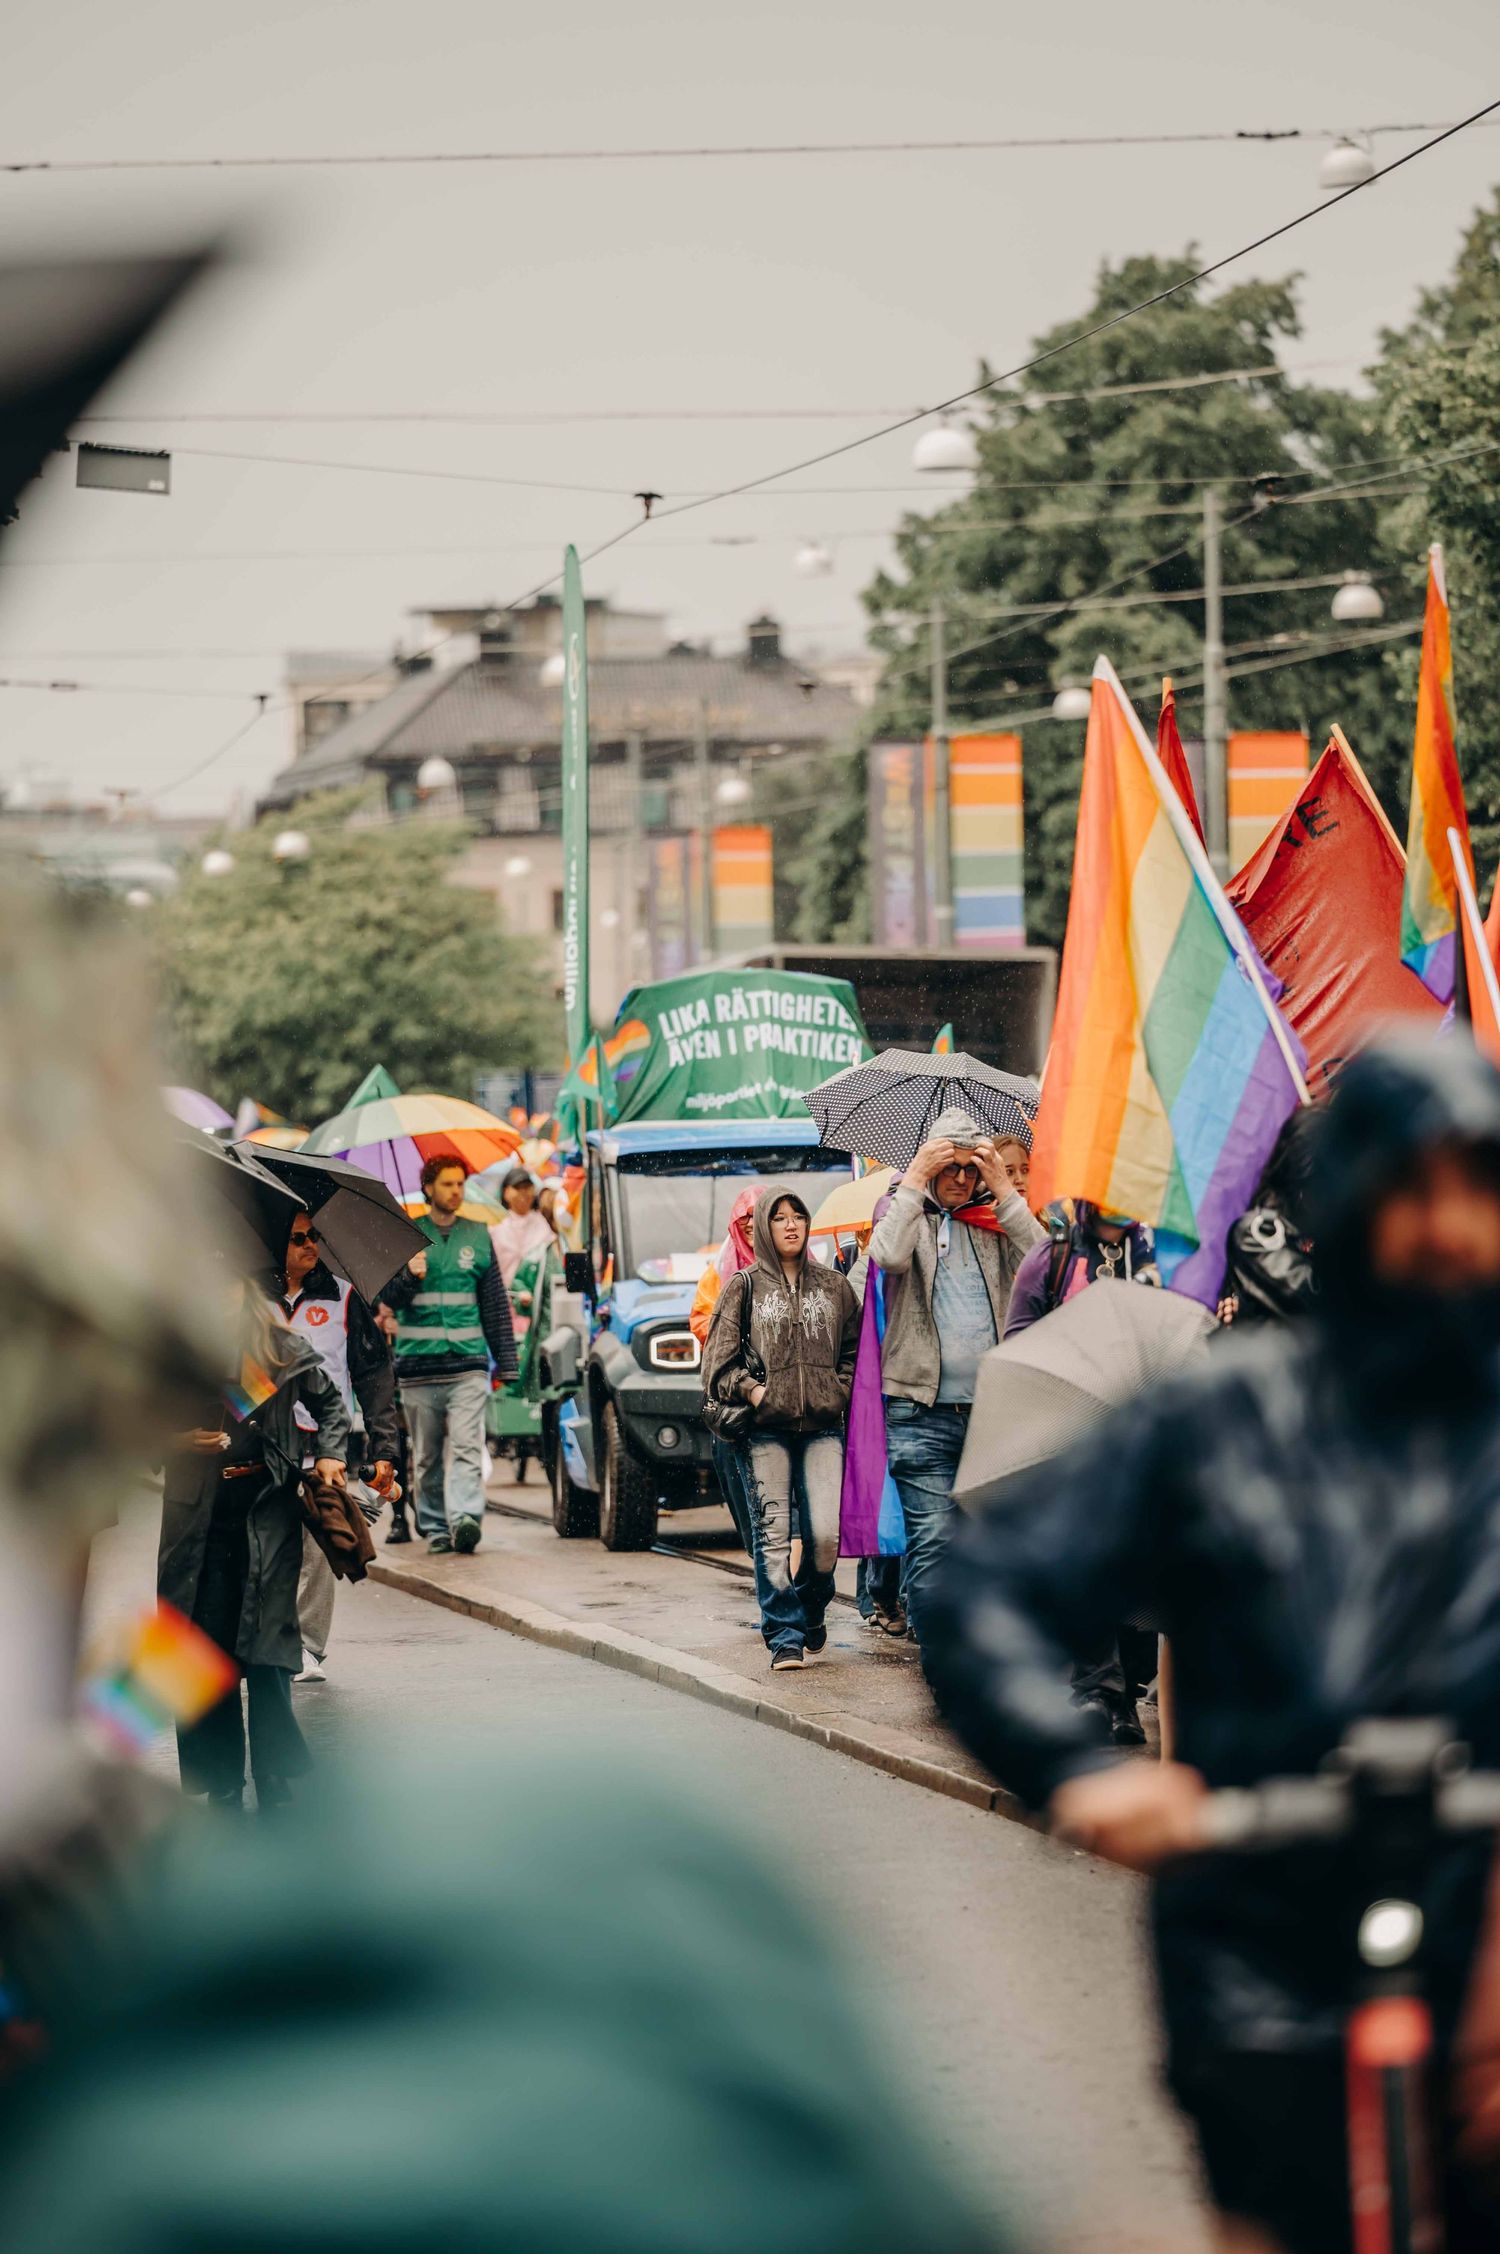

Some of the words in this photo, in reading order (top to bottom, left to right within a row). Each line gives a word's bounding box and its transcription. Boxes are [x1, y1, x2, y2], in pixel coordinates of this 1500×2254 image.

[658, 999, 711, 1040] LIKA
[714, 987, 858, 1032] RÄTTIGHETE
[667, 1028, 721, 1068] ÄVEN
[727, 1028, 738, 1056] I
[743, 1022, 863, 1065] PRAKTIKEN
